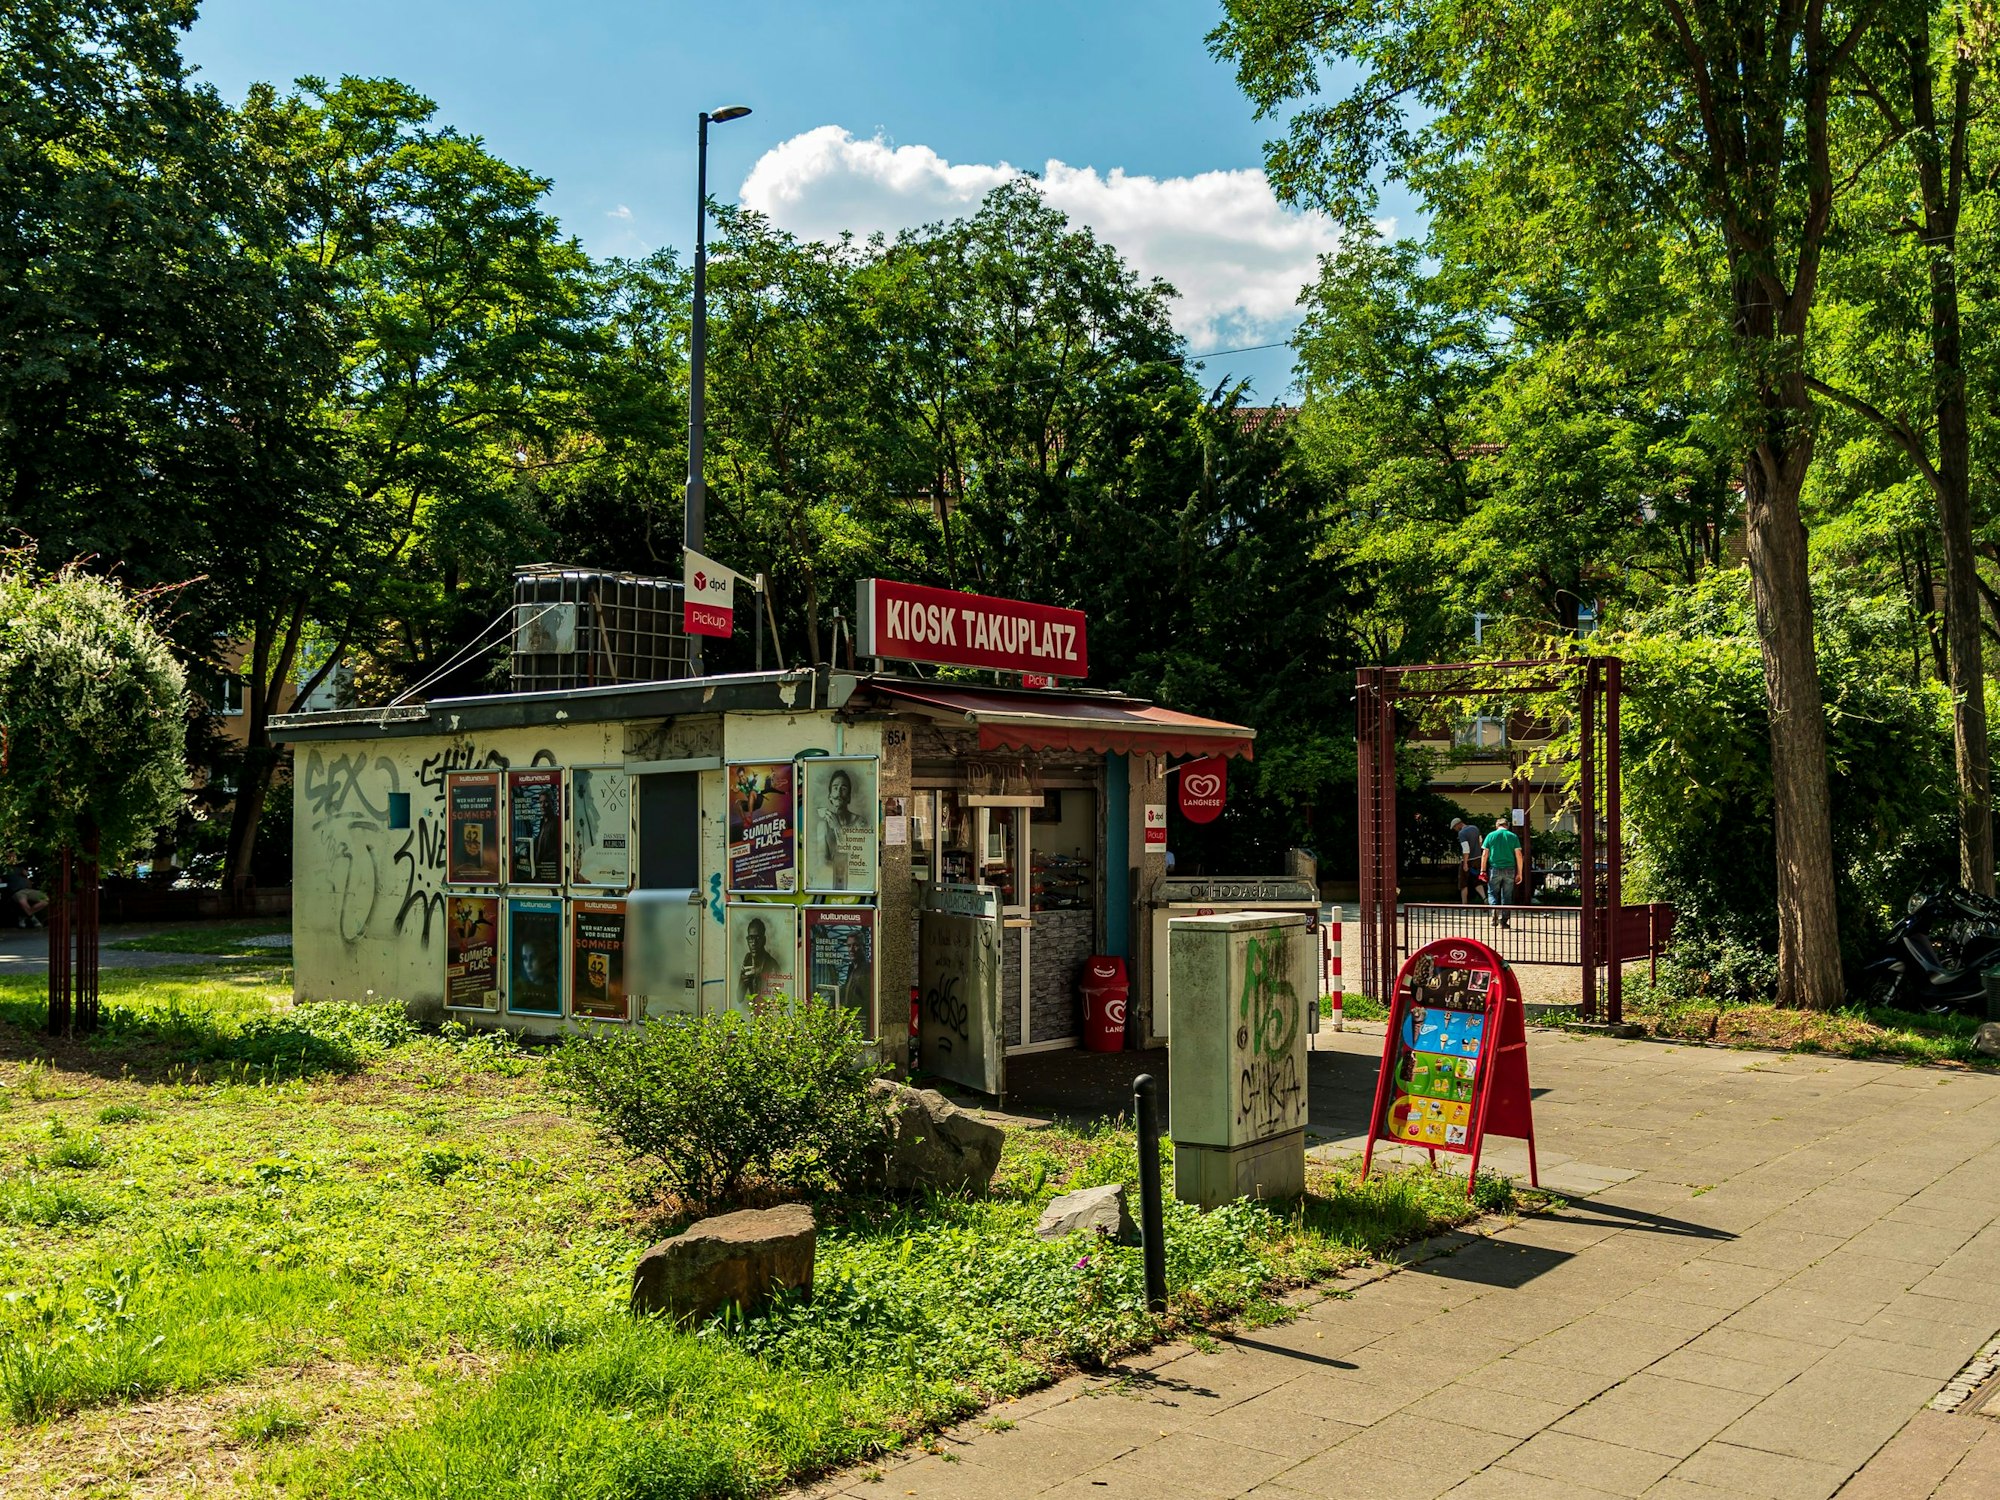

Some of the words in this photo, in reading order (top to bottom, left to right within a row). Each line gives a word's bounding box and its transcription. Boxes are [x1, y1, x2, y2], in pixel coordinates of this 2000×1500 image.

[709, 578, 726, 592] dpd
[692, 611, 726, 630] Pickup
[887, 598, 957, 647] KIOSK
[962, 609, 1078, 662] TAKUPLATZ
[466, 830, 478, 840] 42
[742, 818, 786, 841] SUMMER
[1148, 830, 1164, 840] Pickup
[459, 946, 493, 963] SUMMER
[590, 960, 604, 971] 42
